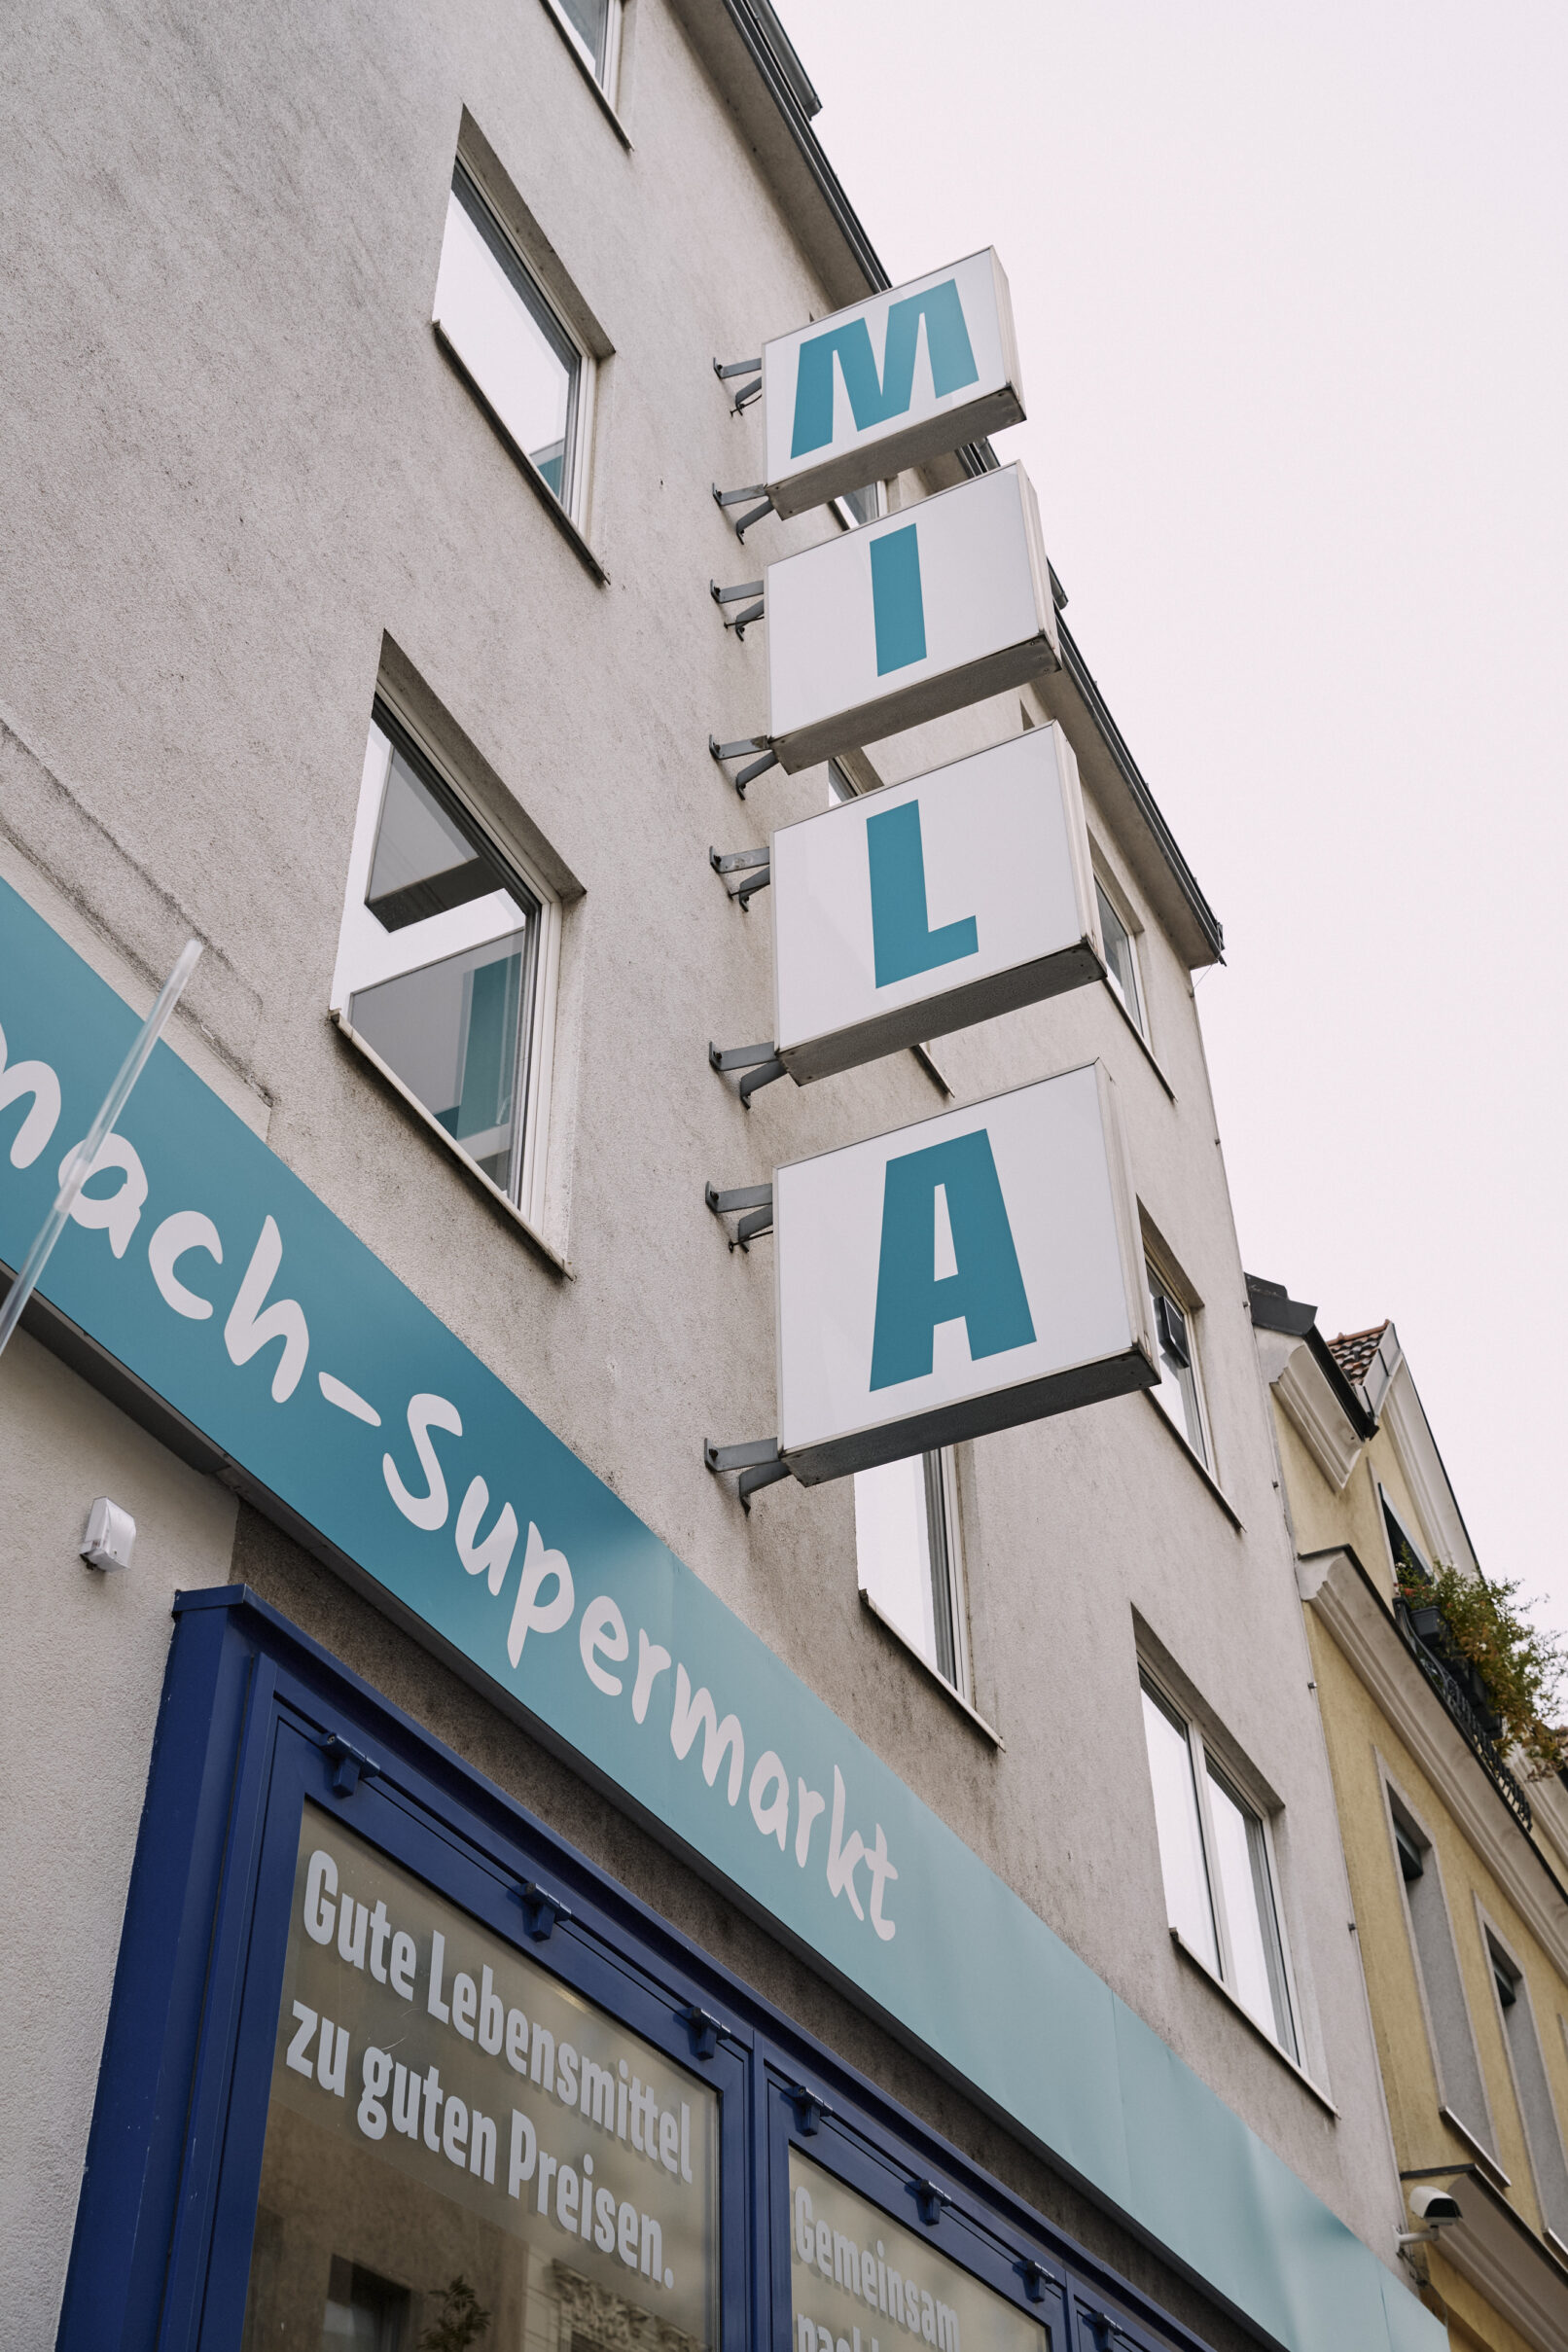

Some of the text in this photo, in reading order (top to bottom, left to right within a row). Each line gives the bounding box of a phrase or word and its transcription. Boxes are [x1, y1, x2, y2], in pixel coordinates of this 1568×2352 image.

[790, 278, 1038, 1392] MILA
[286, 1999, 675, 2290] zu guten Preisen.
[303, 1850, 693, 2184] Gute Lebensmittel
[794, 2186, 960, 2352] Gemeinsam
